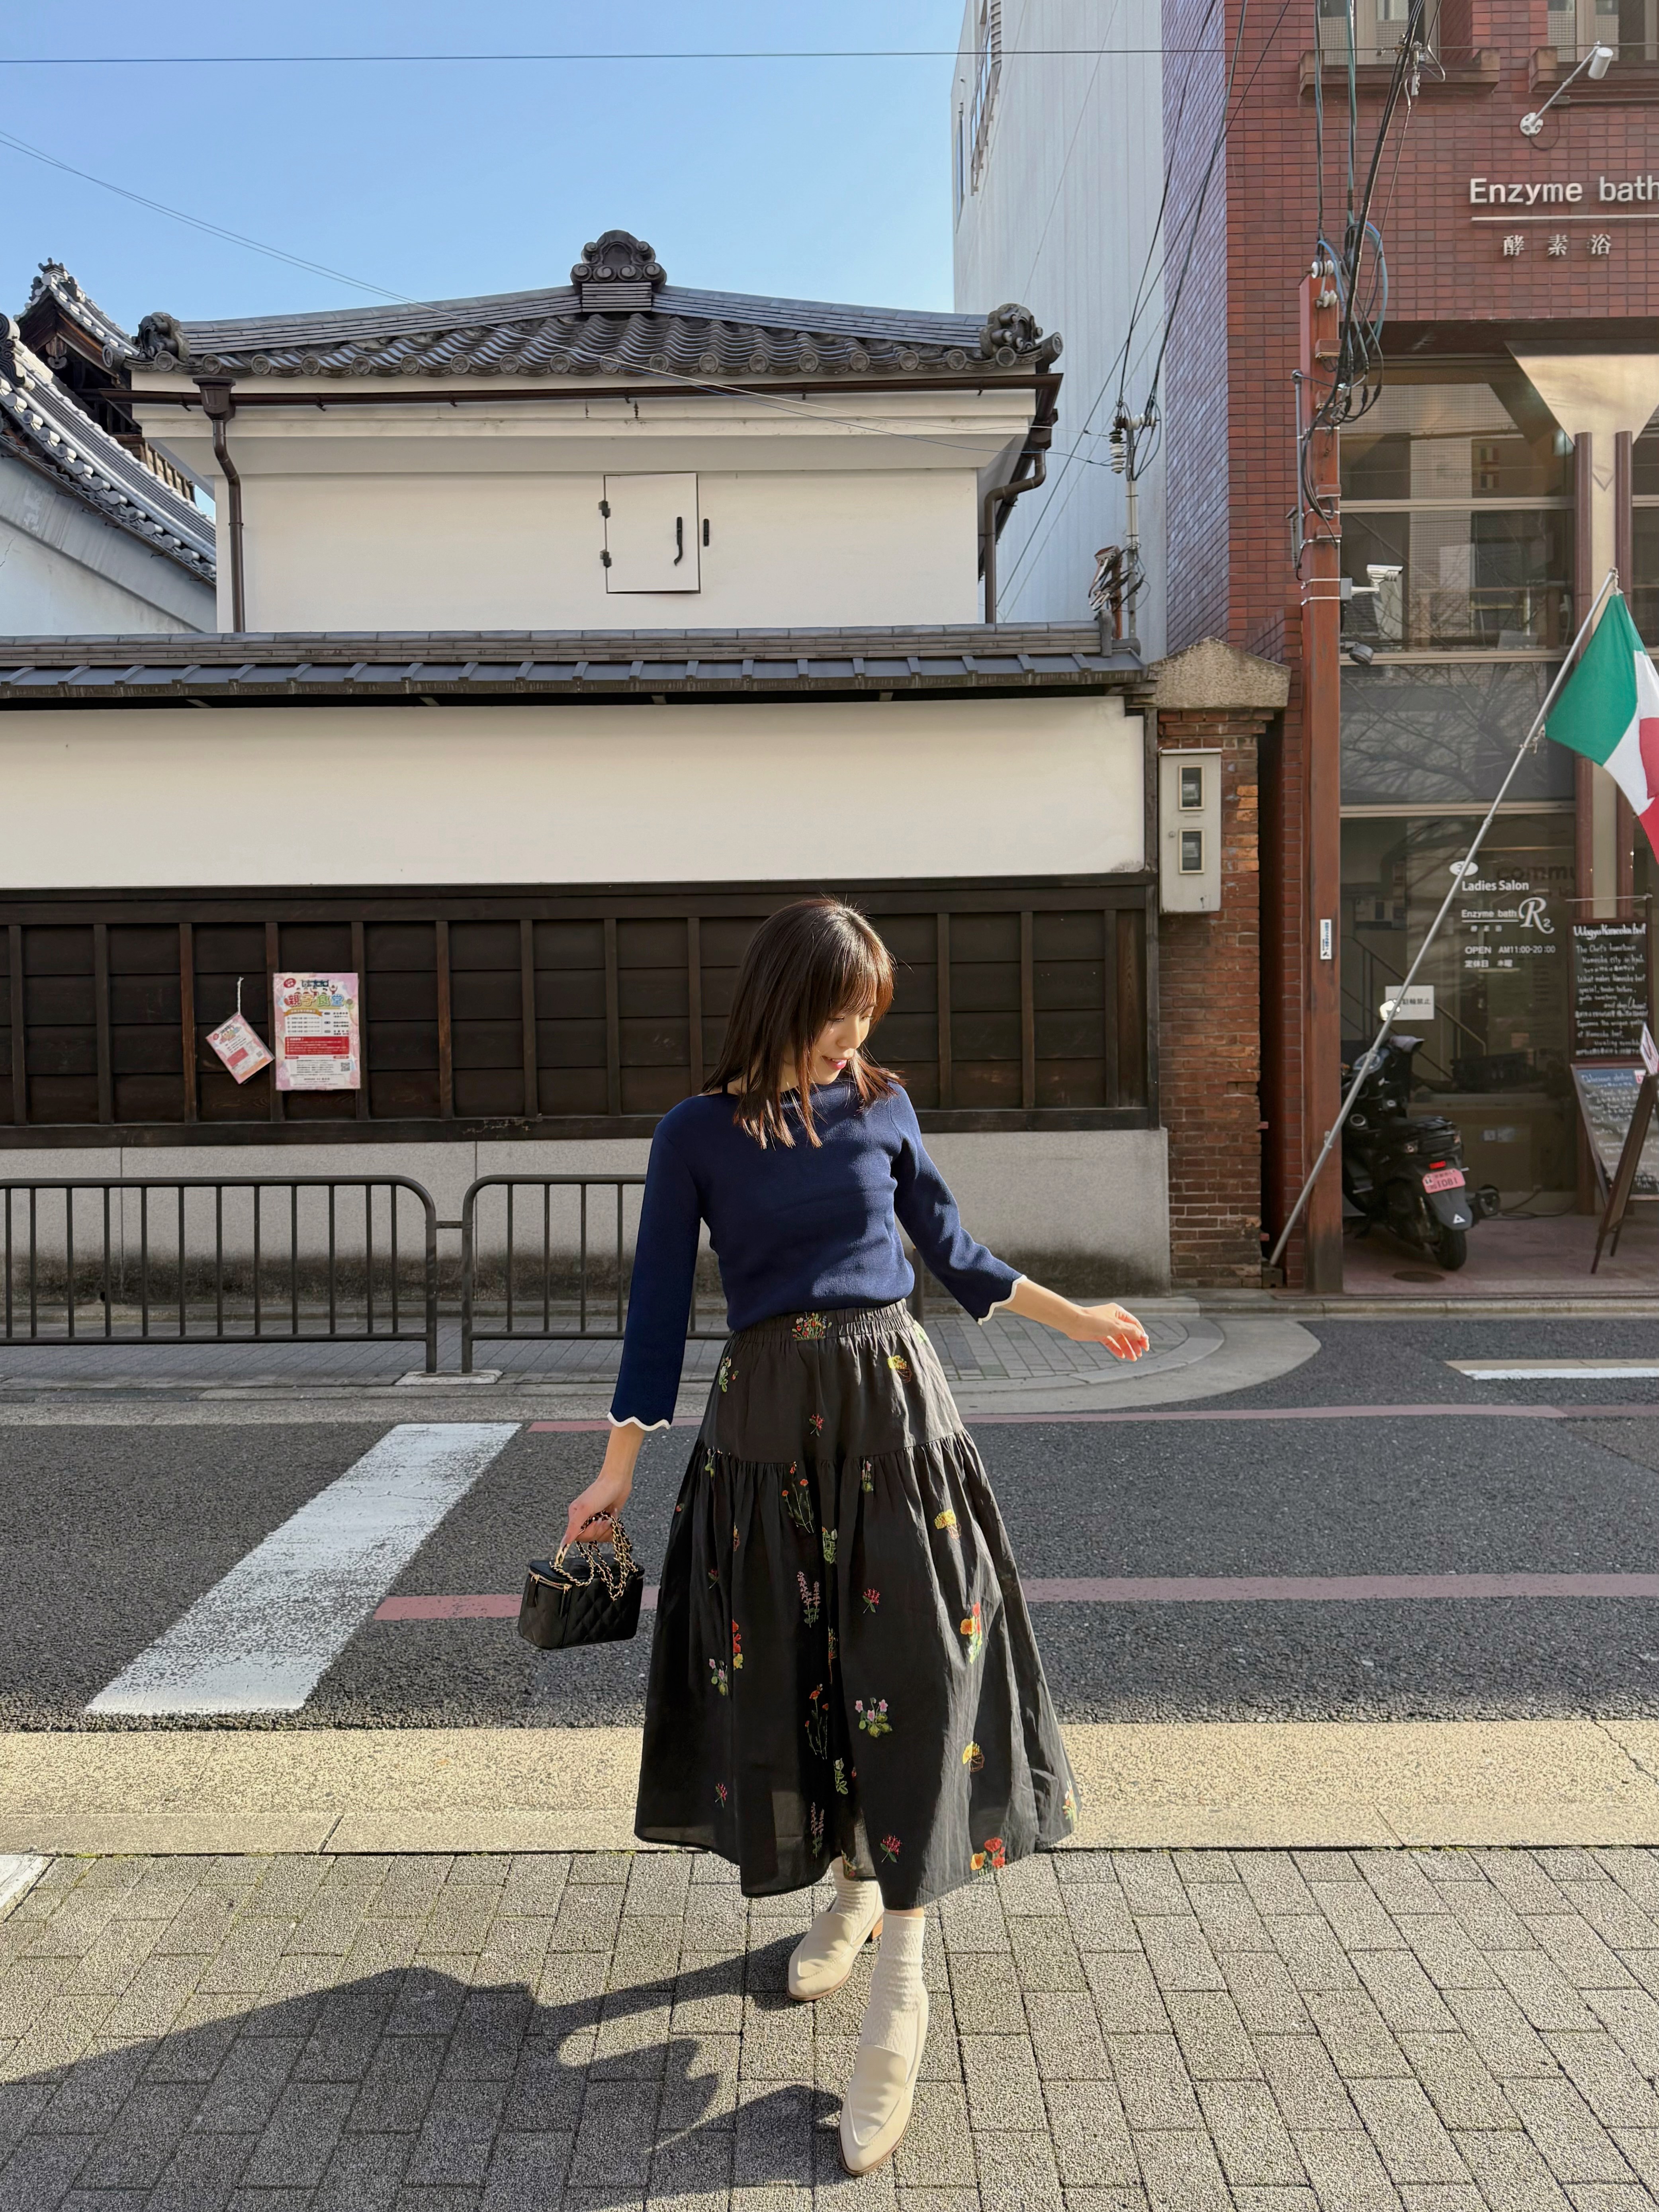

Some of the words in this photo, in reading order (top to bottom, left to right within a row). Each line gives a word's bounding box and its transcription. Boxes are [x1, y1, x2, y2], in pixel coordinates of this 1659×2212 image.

[1470, 177, 1583, 205] Enzyme
[1599, 175, 1659, 202] bath
[1503, 234, 1612, 257] 酵素浴
[1462, 880, 1497, 892] Ladies
[1499, 880, 1529, 891] Salon
[1461, 909, 1494, 918] Enzyme
[1497, 909, 1517, 918] bath
[1464, 946, 1492, 954] OPEN
[288, 993, 344, 1007] 親子食堂
